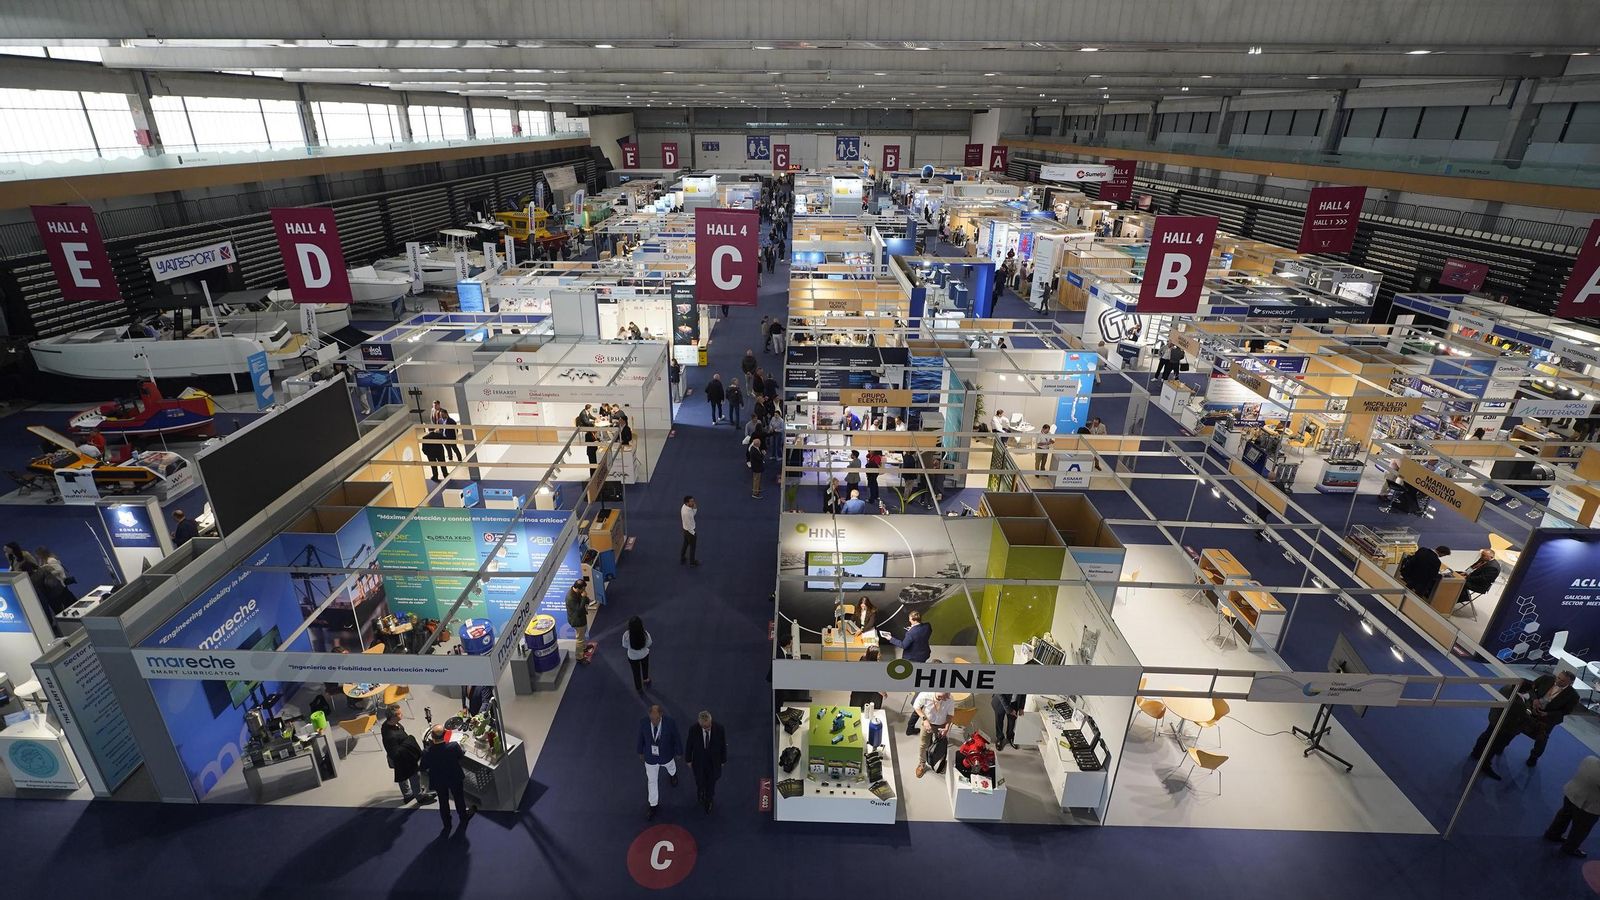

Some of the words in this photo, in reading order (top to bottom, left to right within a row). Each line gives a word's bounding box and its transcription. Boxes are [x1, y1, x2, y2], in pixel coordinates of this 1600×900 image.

[627, 153, 635, 166] E
[665, 153, 674, 165] D
[777, 154, 786, 167] C
[886, 154, 895, 168] B
[992, 155, 1002, 168] A
[1319, 201, 1343, 211] HALL
[1343, 201, 1351, 210] 4
[47, 221, 79, 234] HALL
[80, 221, 89, 236] 4
[285, 222, 317, 235] HALL
[318, 223, 327, 235] 4
[706, 223, 737, 236] HALL
[740, 224, 748, 237] 4
[1162, 231, 1193, 244] HALL
[1195, 232, 1204, 245] 4
[61, 242, 102, 288] E
[295, 243, 332, 289] D
[459, 256, 467, 279] odman
[711, 244, 743, 291] C
[1154, 252, 1192, 298] B
[1414, 477, 1462, 508] CONSULTING
[1424, 475, 1455, 497] MARINO
[808, 528, 847, 539] HINE
[202, 586, 231, 611] reliability
[198, 598, 258, 650] mareche
[223, 608, 261, 643] LUBRICATION
[497, 601, 530, 664] mareche
[63, 647, 87, 668] Sector
[73, 652, 96, 672] Experien
[75, 657, 98, 677] corporat
[146, 655, 236, 670] mareche
[182, 669, 240, 677] LUBRICATION
[382, 666, 424, 674] Lubricación
[914, 668, 998, 690] HINE
[44, 676, 55, 692] SEA
[51, 692, 65, 712] TALENT
[62, 713, 72, 725] THE
[650, 840, 675, 871] C
